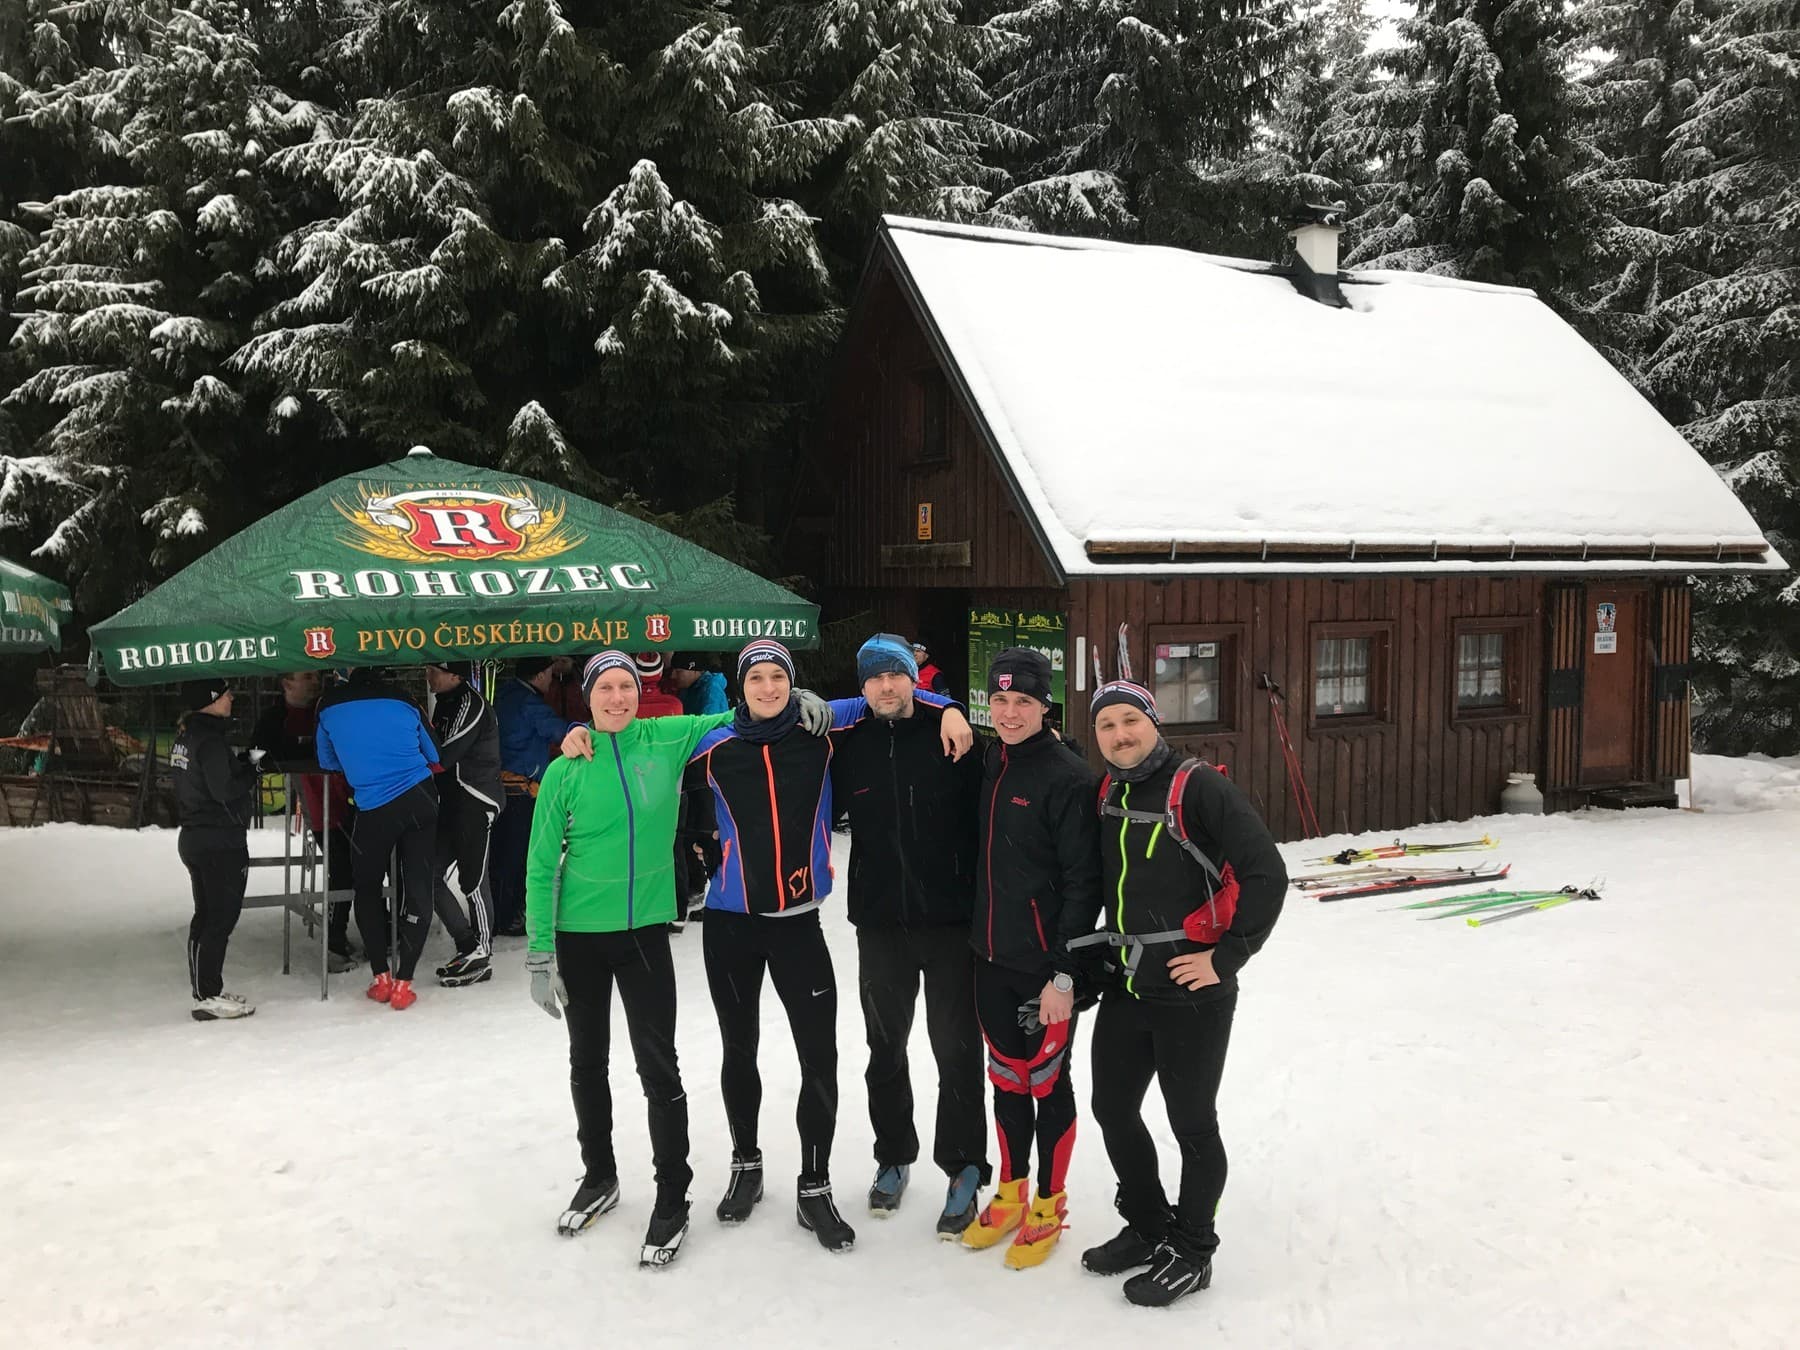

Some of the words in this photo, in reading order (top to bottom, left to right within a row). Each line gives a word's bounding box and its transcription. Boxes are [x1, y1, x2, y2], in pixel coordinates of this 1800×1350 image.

[419, 508, 510, 547] R
[290, 563, 656, 600] ROHOZEC
[310, 631, 330, 652] R
[358, 628, 427, 652] PIVO
[434, 620, 564, 648] ČESKÉHO
[572, 617, 630, 646] RÁJE
[650, 618, 667, 637] R
[693, 619, 807, 637] ROHOZEC
[116, 636, 278, 670] ROHOZEC
